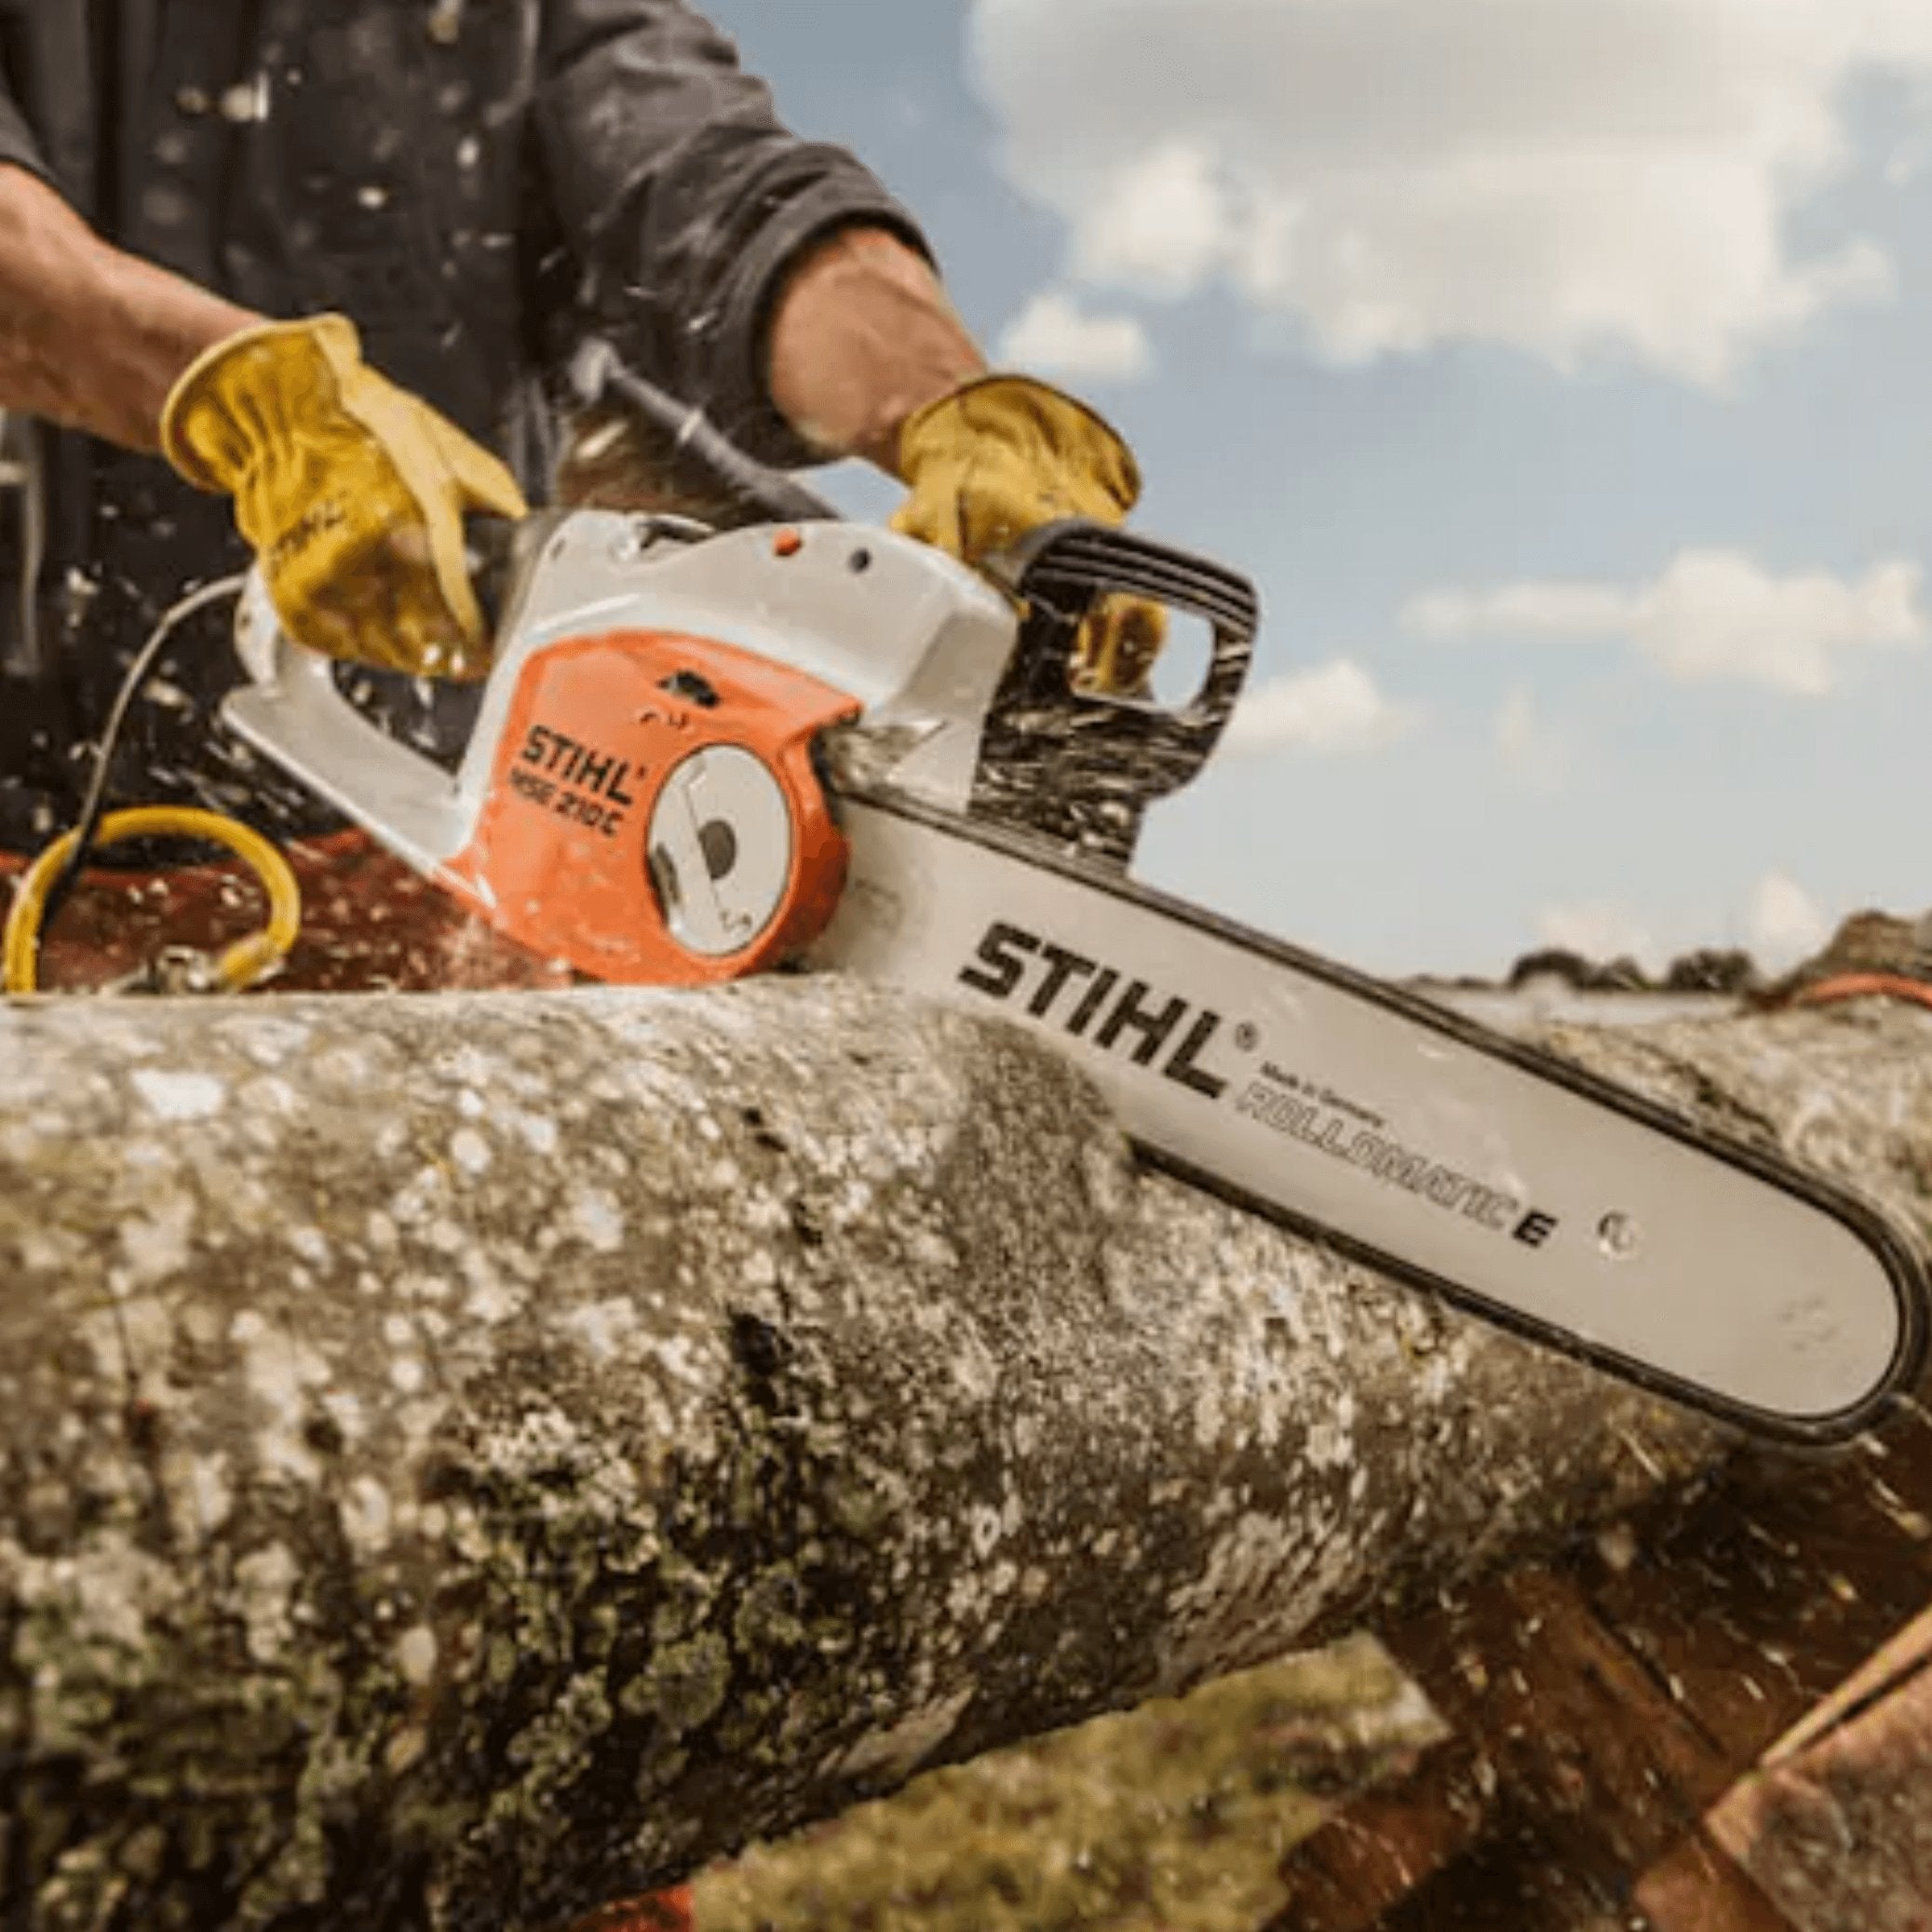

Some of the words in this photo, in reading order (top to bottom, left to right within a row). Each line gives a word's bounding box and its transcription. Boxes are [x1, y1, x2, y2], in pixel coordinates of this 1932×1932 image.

[521, 723, 633, 807] STIHL
[957, 919, 1229, 1100] STIHL
[1235, 1079, 1520, 1233] ROLLOMATIC
[1512, 1207, 1559, 1249] E
